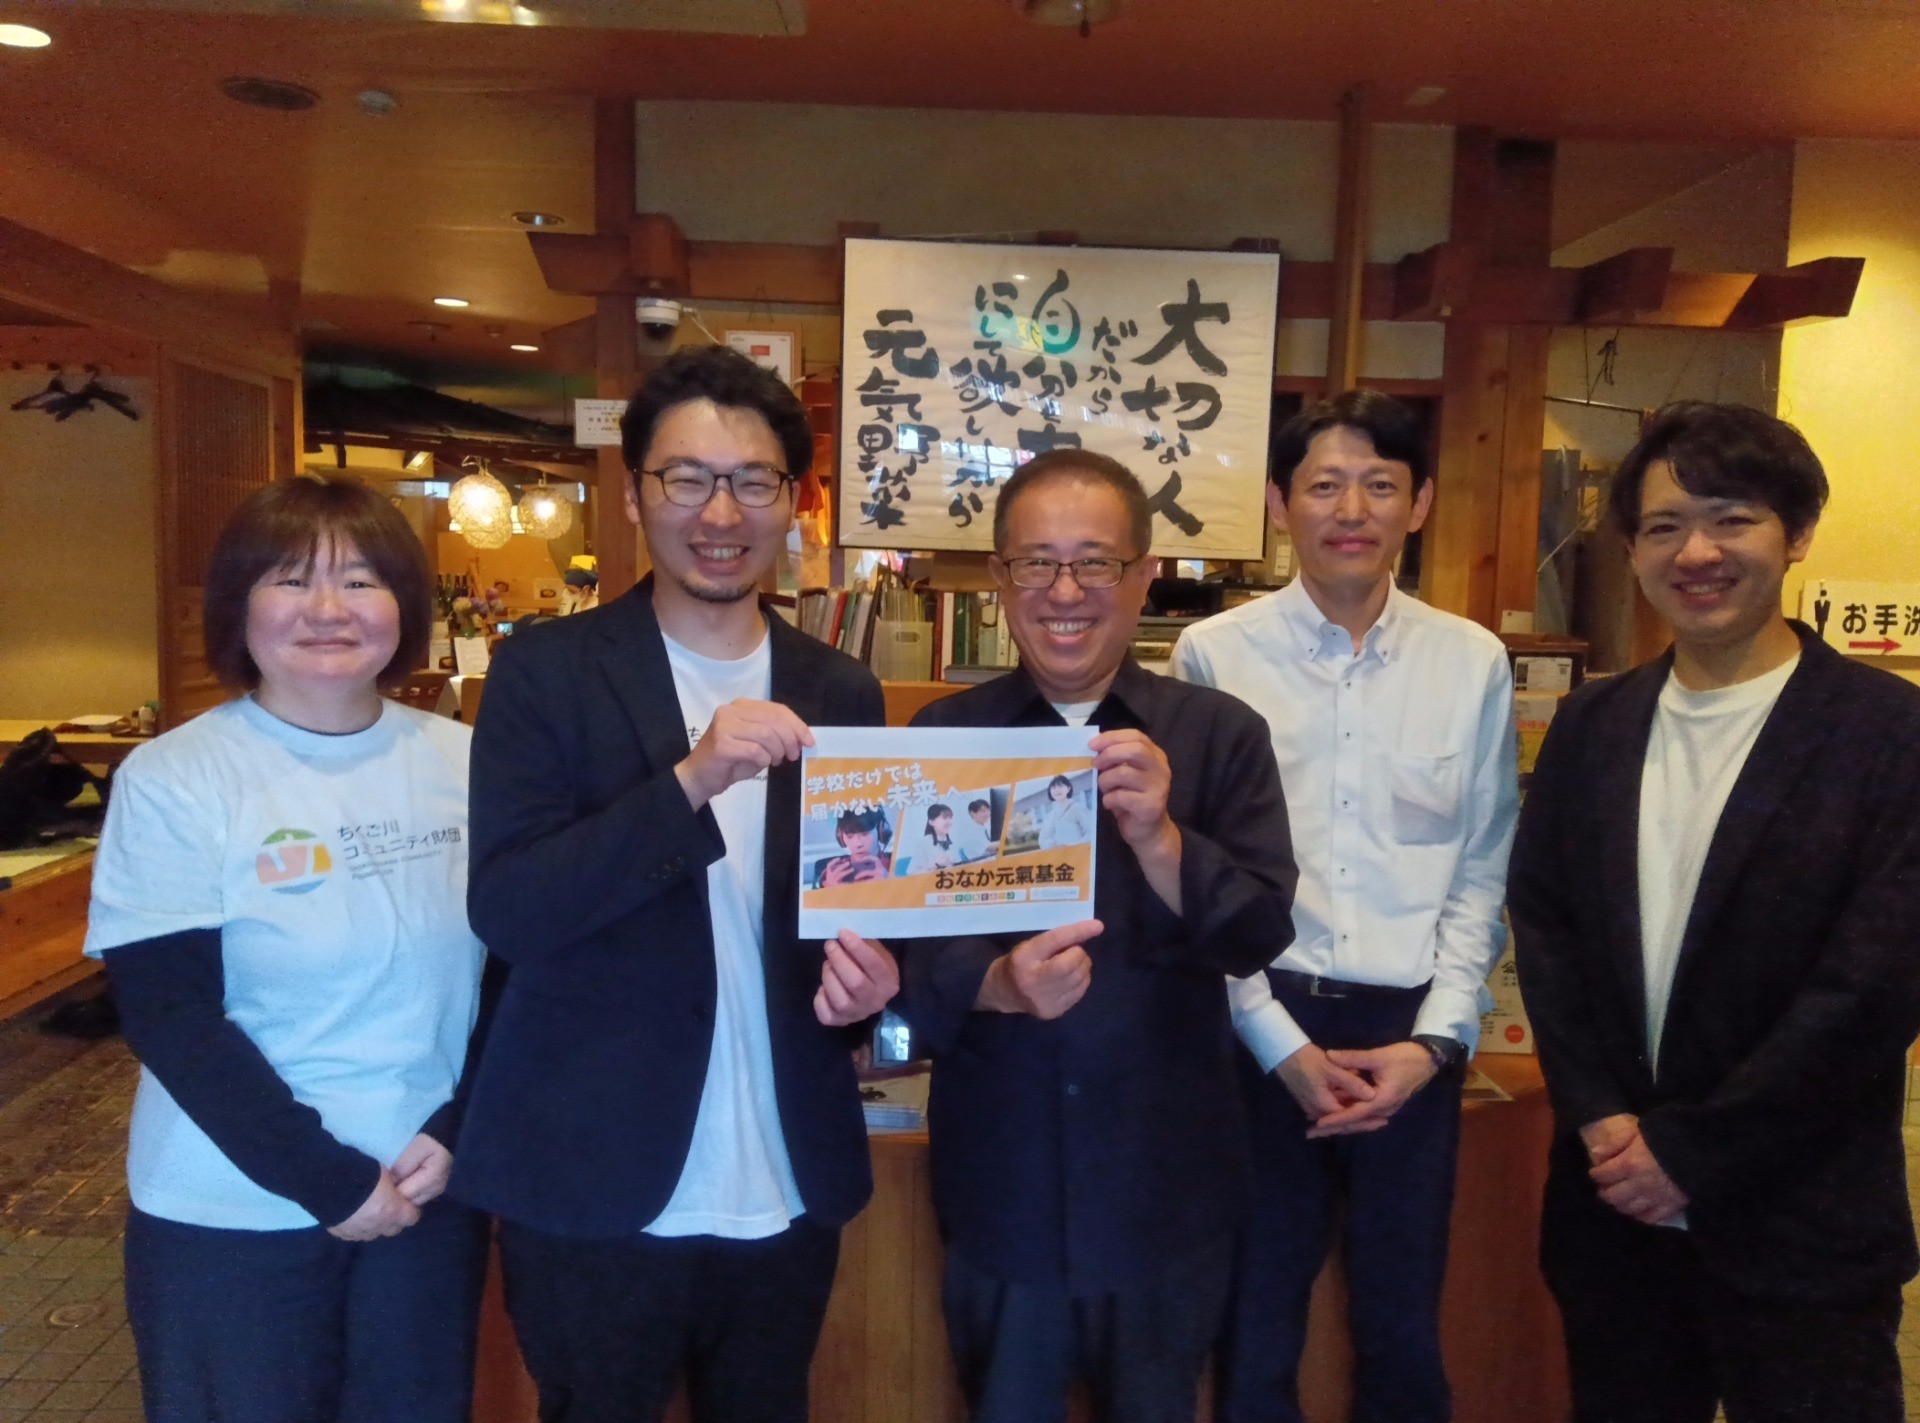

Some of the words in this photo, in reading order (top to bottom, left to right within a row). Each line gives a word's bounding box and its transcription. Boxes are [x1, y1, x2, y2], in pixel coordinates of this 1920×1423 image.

[1121, 278, 1231, 537] 大切な人
[806, 761, 923, 796] 学校だけでは
[342, 827, 462, 860] コミュニティ財団
[935, 863, 1075, 890] おなか元氣基金
